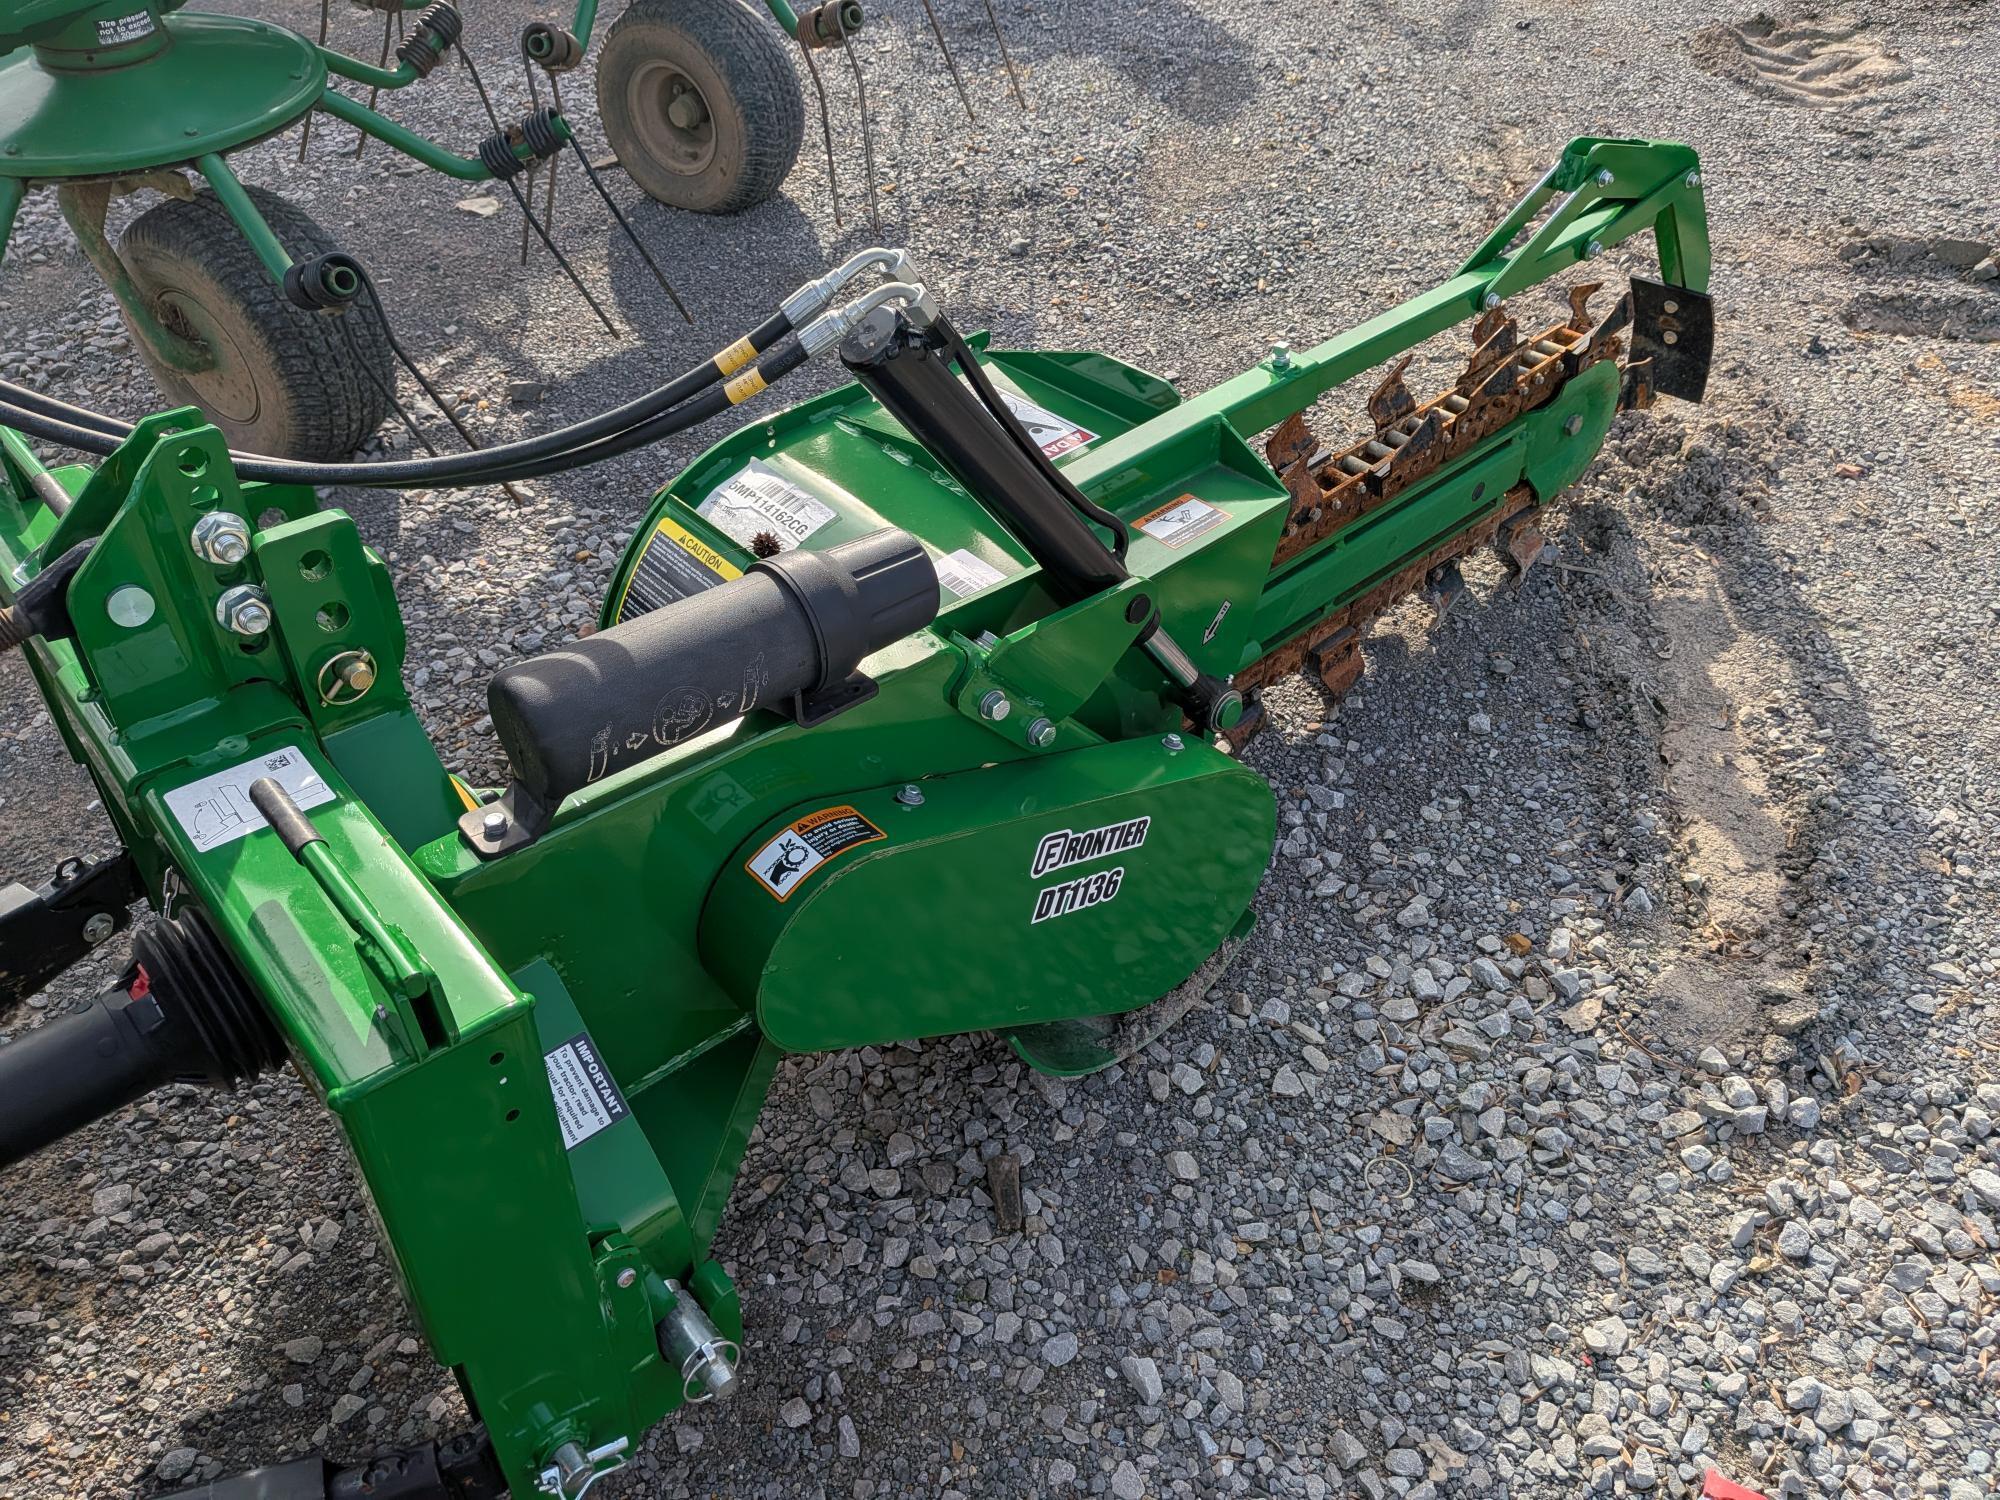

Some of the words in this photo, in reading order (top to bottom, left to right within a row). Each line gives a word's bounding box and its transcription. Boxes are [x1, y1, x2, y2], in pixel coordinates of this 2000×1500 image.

[99, 20, 116, 28] Tire
[119, 10, 147, 26] pressure
[100, 28, 114, 36] not
[128, 15, 151, 29] exceed
[728, 481, 808, 536] 5MP114162CG
[686, 538, 722, 570] CAUTION
[807, 809, 854, 826] WARNING
[813, 822, 833, 833] avoid
[832, 815, 858, 826] serious
[1032, 818, 1149, 876] FRONTIER
[1034, 868, 1122, 921] DT1136
[549, 1053, 563, 1071] your
[560, 1070, 577, 1099] tractor,
[575, 1098, 588, 1116] read
[560, 1047, 568, 1058] To
[565, 1058, 584, 1087] prevent
[581, 1086, 600, 1117] damage
[597, 1116, 605, 1125] to
[575, 1040, 623, 1114] IMPORTANT
[557, 1086, 566, 1098] for
[563, 1098, 584, 1130] required
